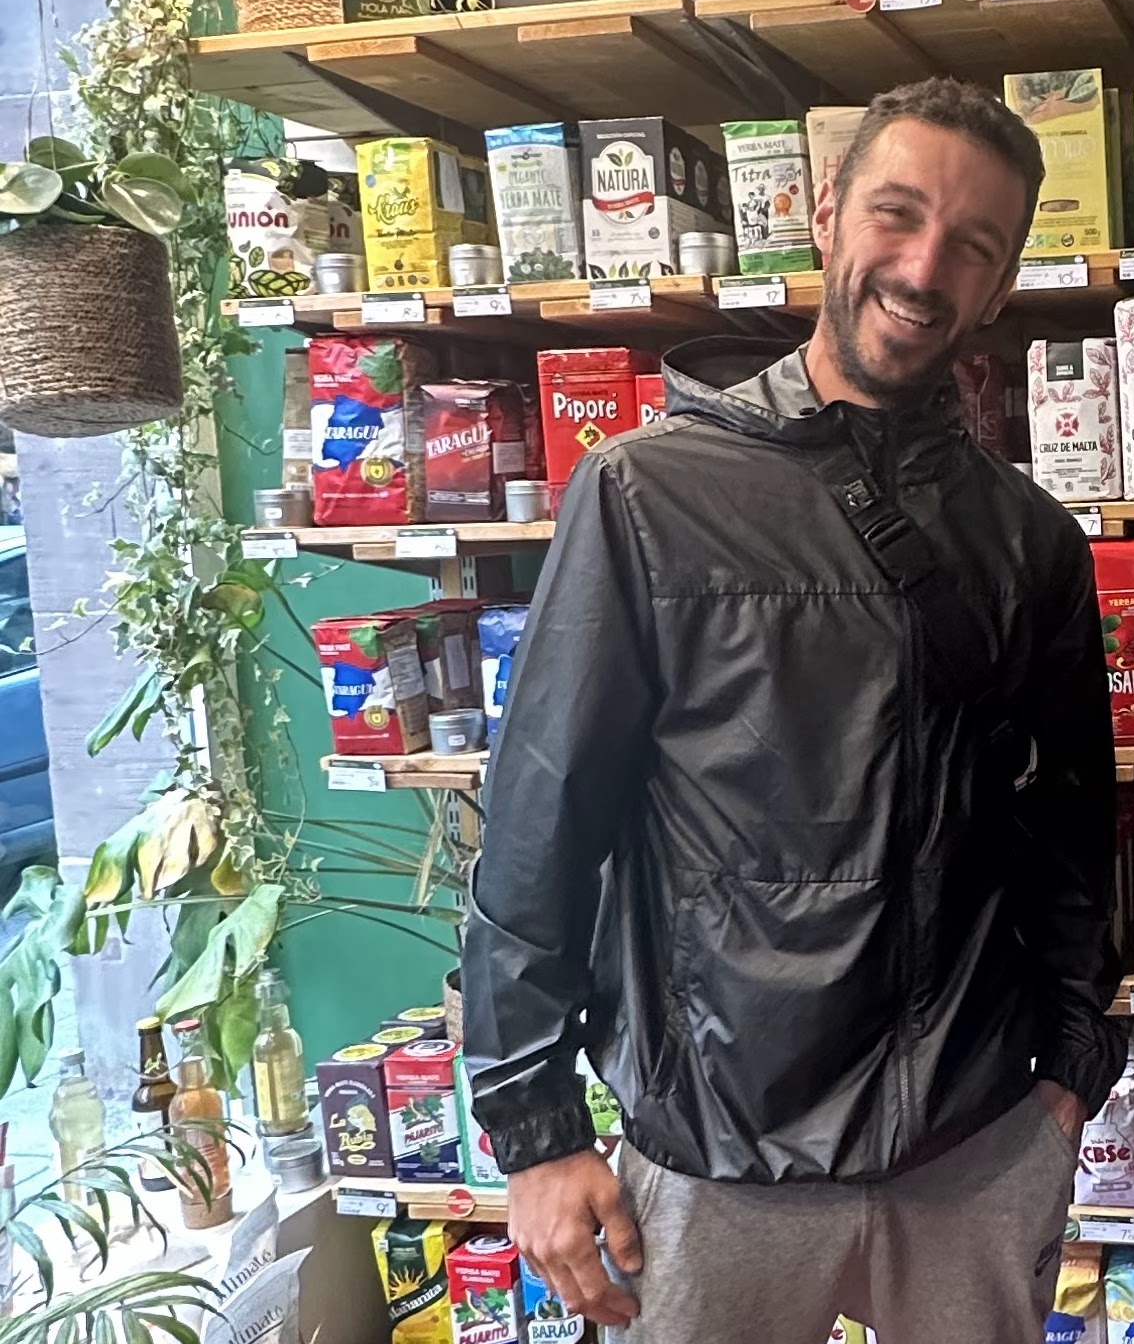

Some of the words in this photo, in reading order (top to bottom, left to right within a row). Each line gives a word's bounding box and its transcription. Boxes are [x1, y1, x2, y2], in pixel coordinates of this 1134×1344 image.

[597, 167, 650, 193] NATURA
[1039, 442, 1059, 453] CRUZ
[1061, 442, 1070, 453] DE
[1072, 441, 1098, 452] MALTA
[404, 1121, 444, 1142] PAJARITO
[1046, 1330, 1082, 1342] RAGUI
